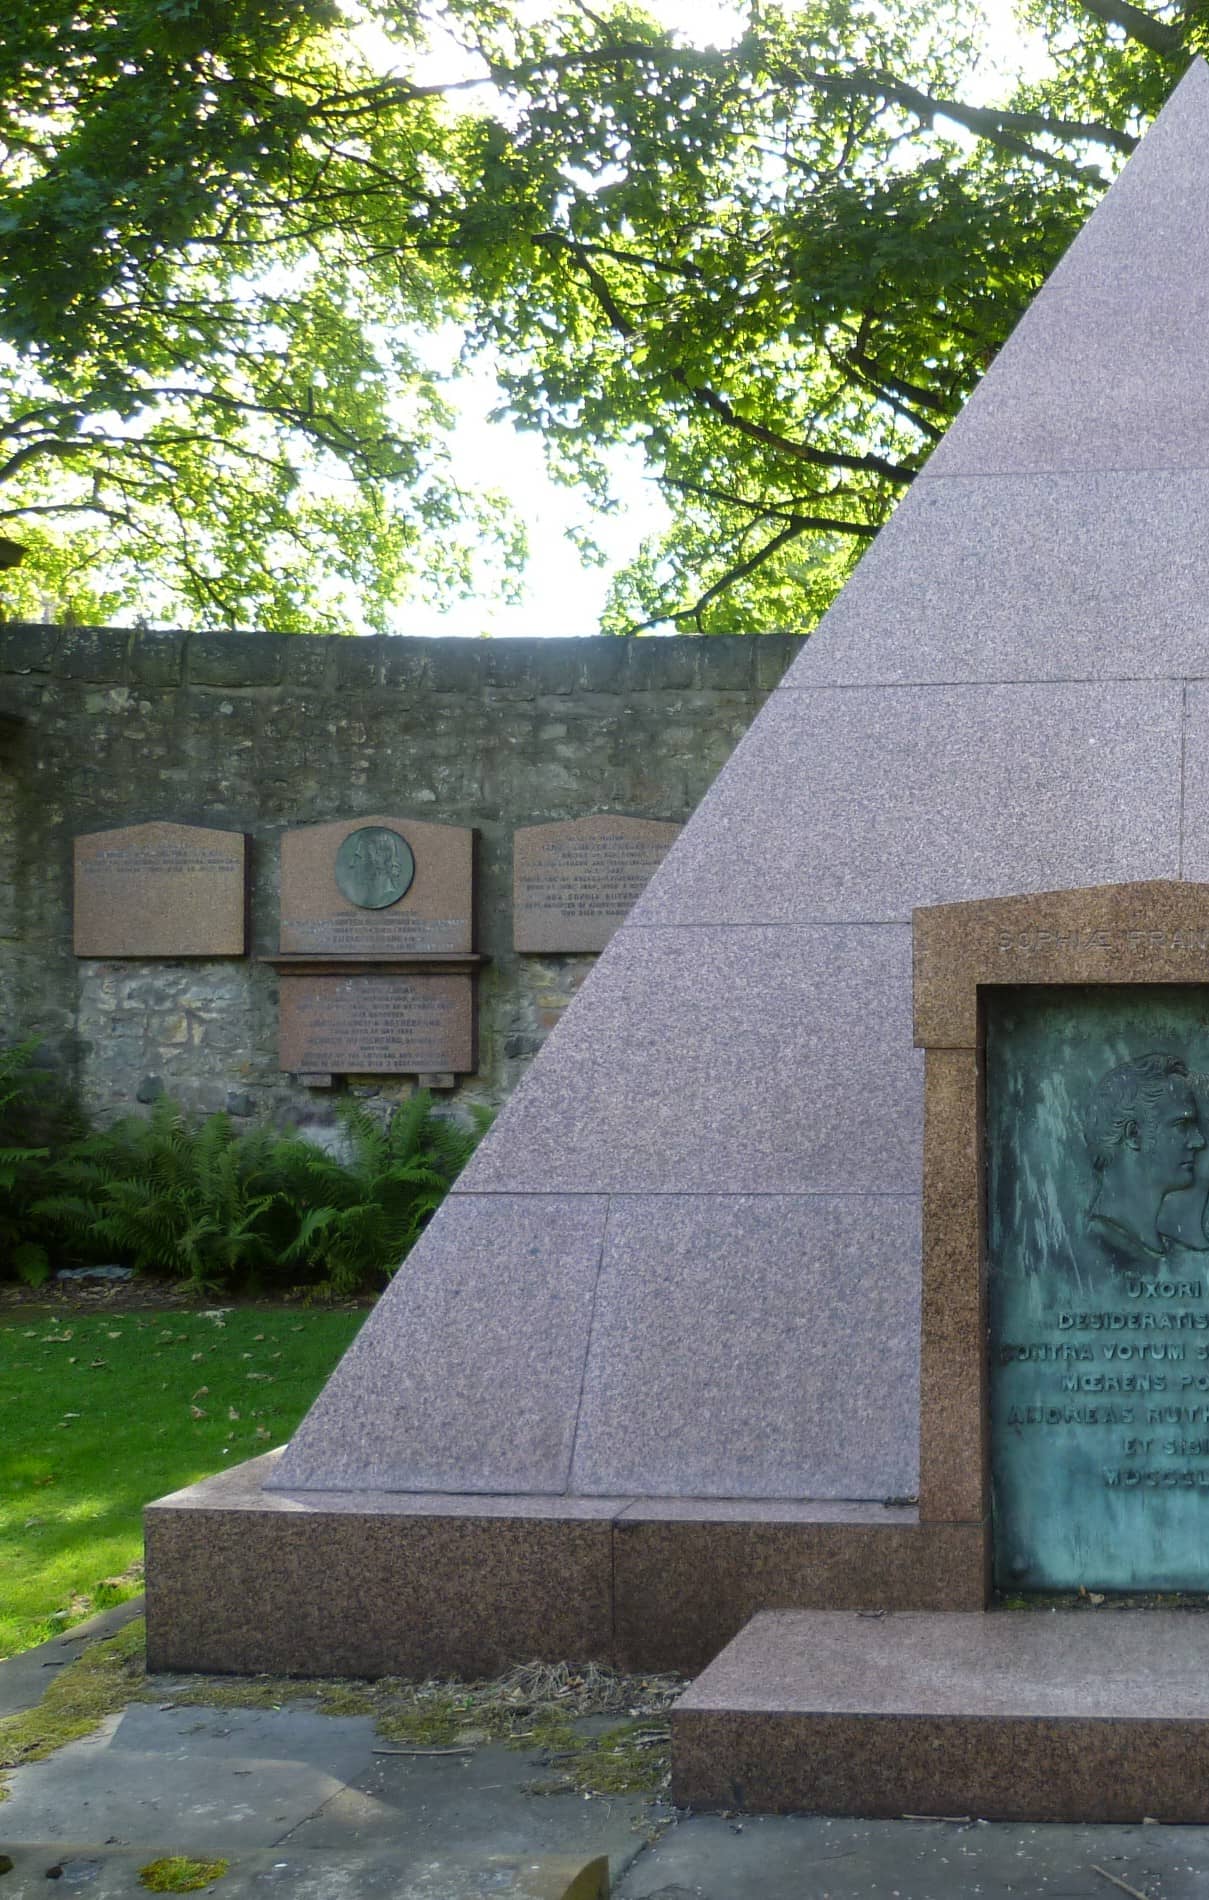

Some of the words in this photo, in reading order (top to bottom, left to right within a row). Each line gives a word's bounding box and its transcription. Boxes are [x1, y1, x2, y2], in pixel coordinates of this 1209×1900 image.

[998, 929, 1112, 950] SOPHIÆ
[1127, 1280, 1203, 1298] UXORI
[1001, 1343, 1095, 1362] ONTRA
[1103, 1343, 1186, 1361] VOTUM
[1061, 1373, 1168, 1392] MŒRENS
[1007, 1404, 1135, 1425] ANDREAS
[1123, 1438, 1153, 1457] ET
